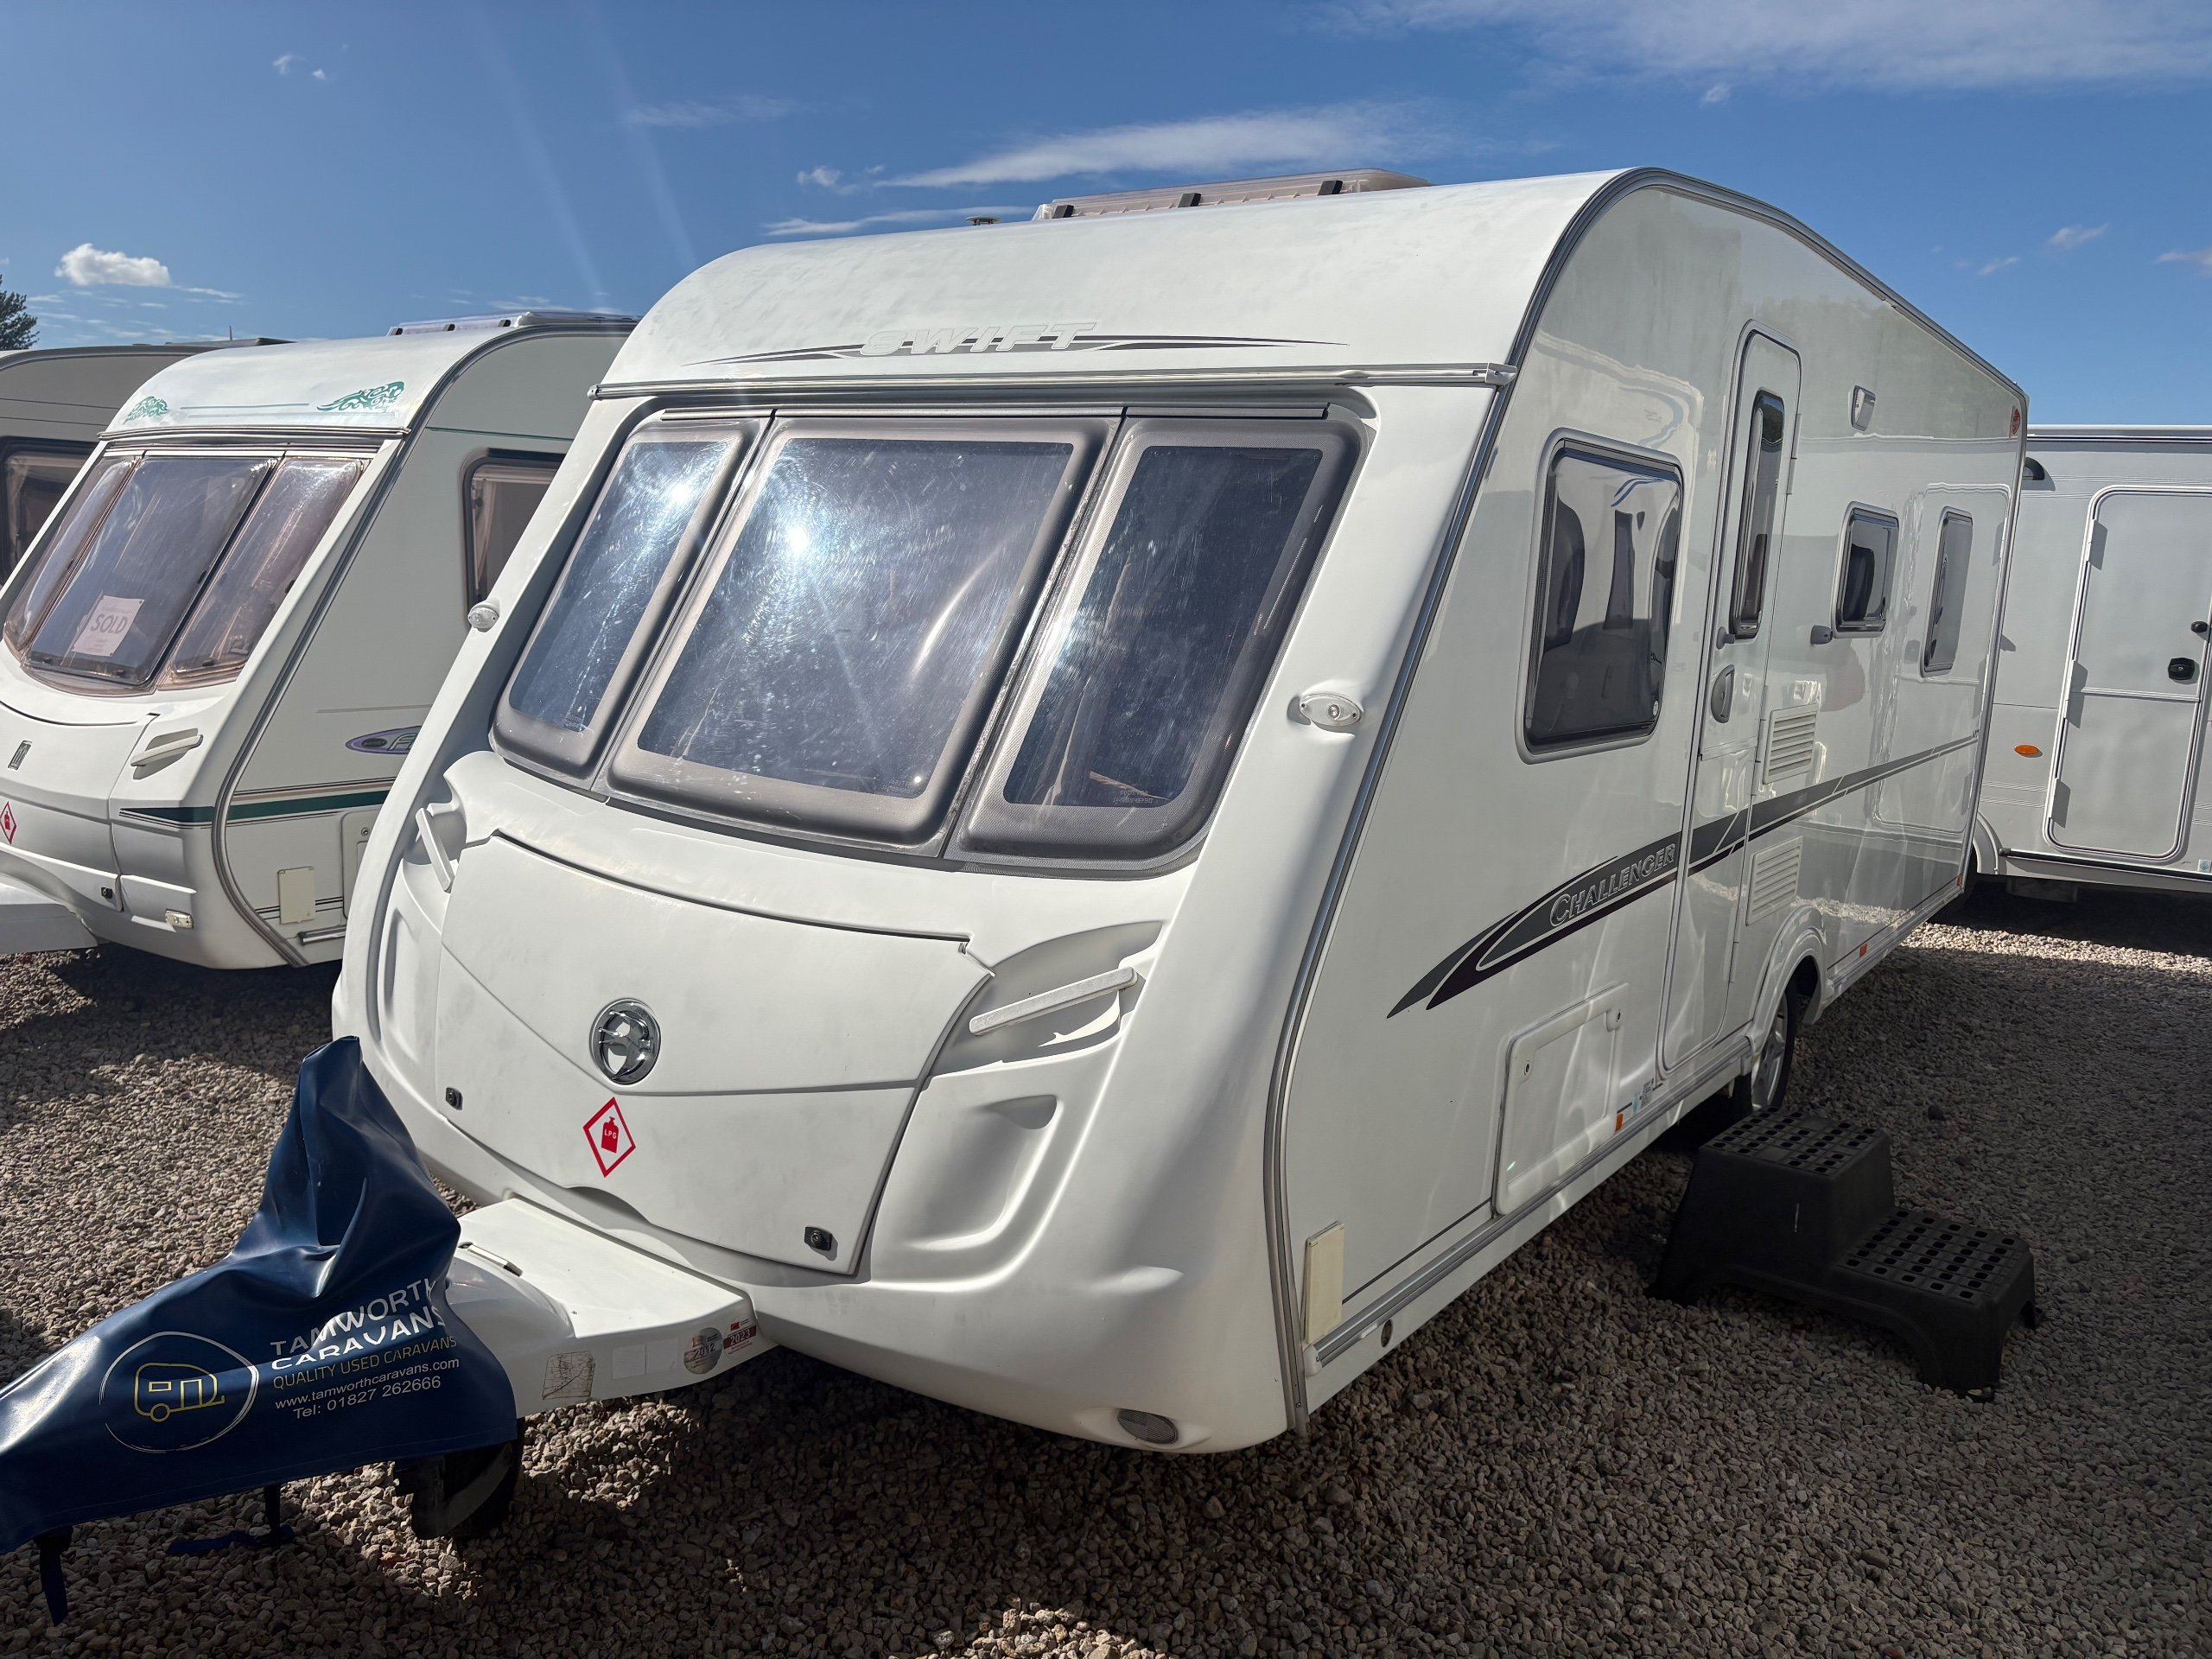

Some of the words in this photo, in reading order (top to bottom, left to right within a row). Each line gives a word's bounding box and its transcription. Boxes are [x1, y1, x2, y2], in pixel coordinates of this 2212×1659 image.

[861, 321, 1097, 355] SWIFT
[90, 613, 128, 634] SOLD
[1550, 843, 1675, 926] CHALLENGER
[604, 1128, 617, 1140] LPG
[271, 1306, 446, 1370] CARAVANS
[730, 1329, 751, 1345] 2023
[273, 1363, 336, 1389] QUALITY
[340, 1355, 379, 1374] USED
[384, 1336, 457, 1363] CARAVANS
[275, 1358, 460, 1409] www.tamworthcaravans.com
[293, 1403, 321, 1420] Tel:
[327, 1389, 377, 1411] 01827
[382, 1376, 442, 1397] 262666
